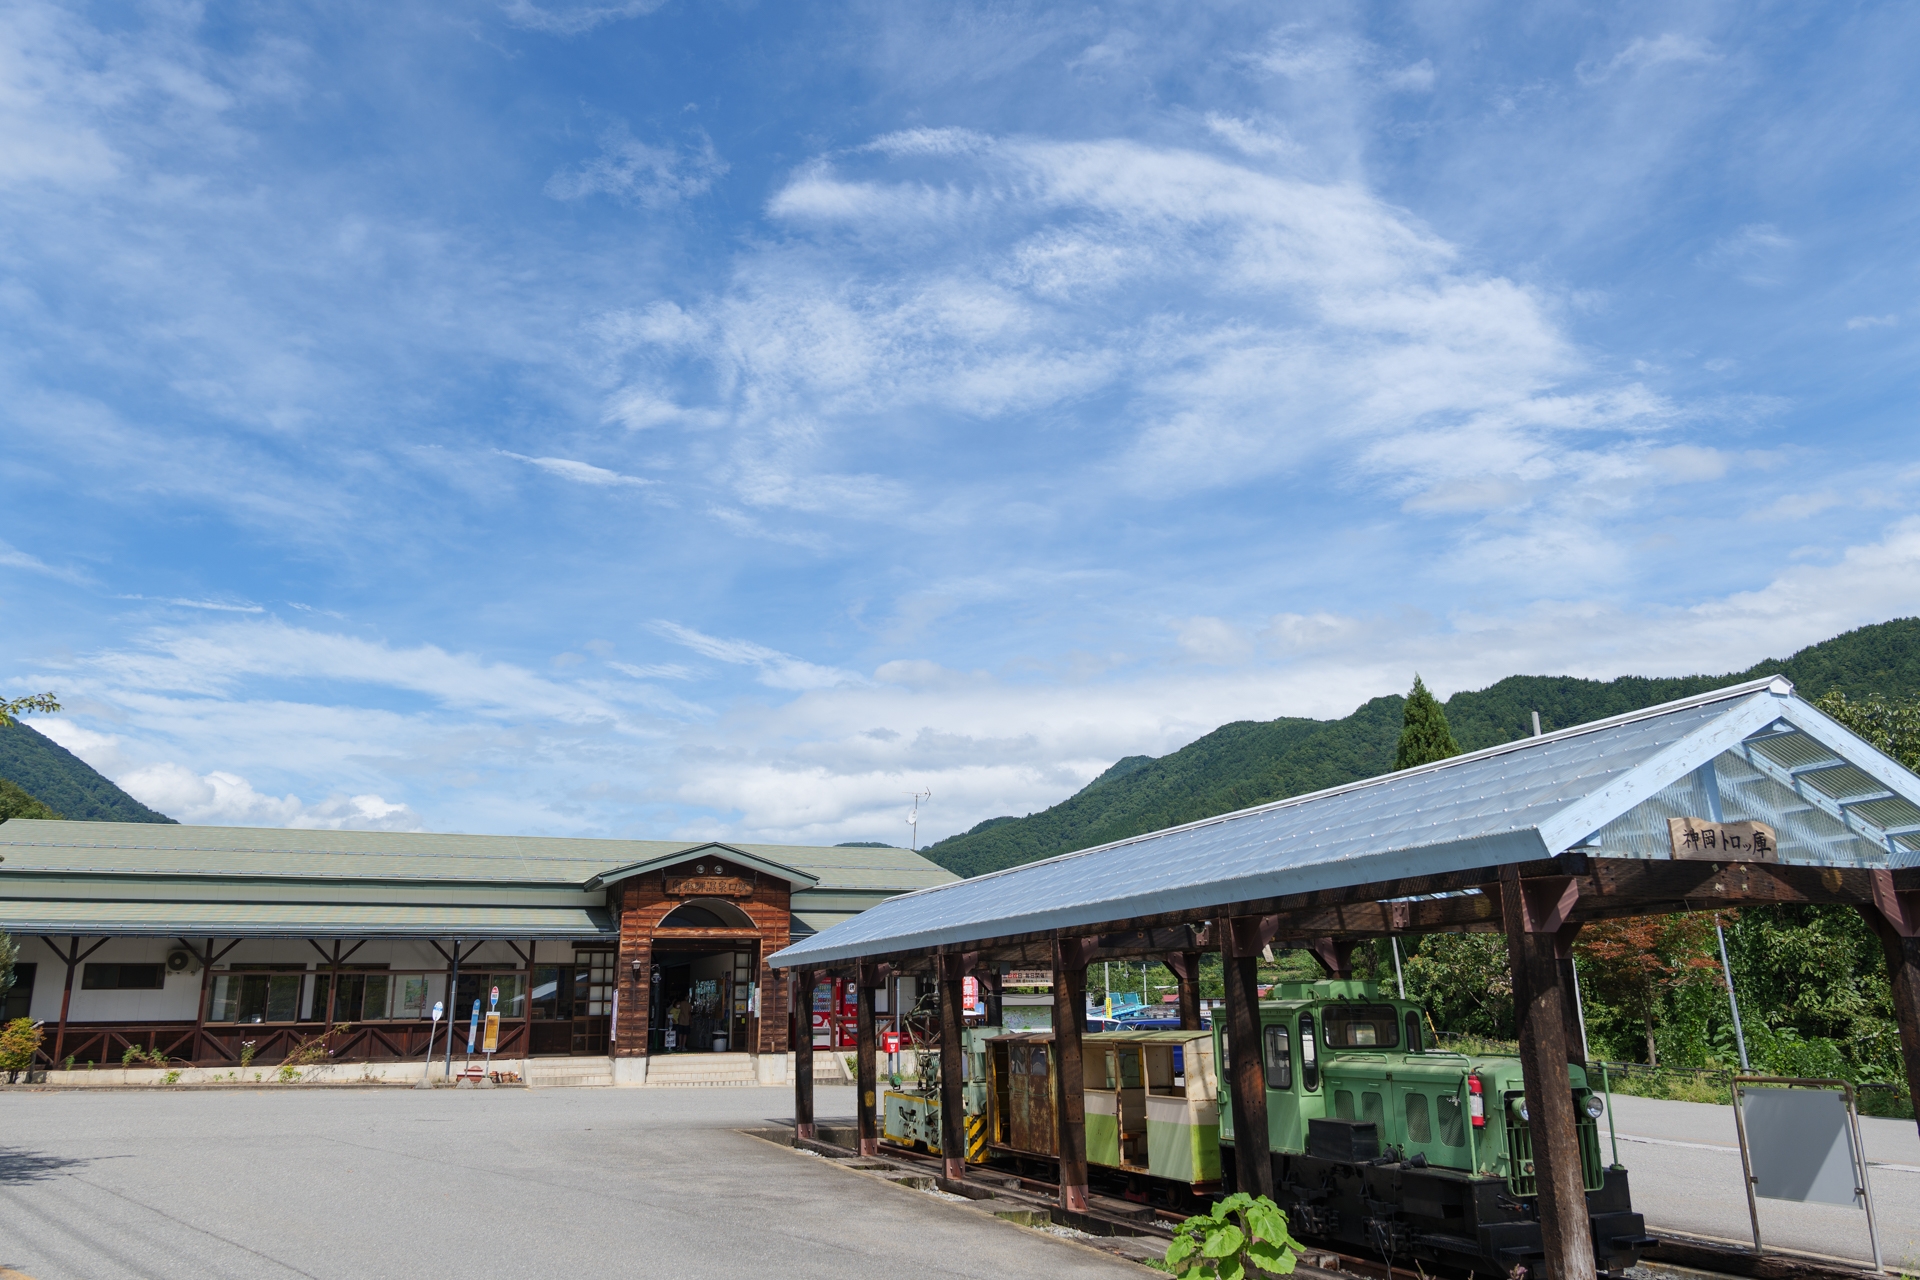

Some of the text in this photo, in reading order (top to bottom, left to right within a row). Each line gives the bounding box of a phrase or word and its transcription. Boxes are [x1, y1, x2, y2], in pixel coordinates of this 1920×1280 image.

[1682, 827, 1771, 858] 神岡トロッ庫
[671, 879, 749, 892] 奥飛騨温泉口駅
[963, 976, 973, 1006] 営業中
